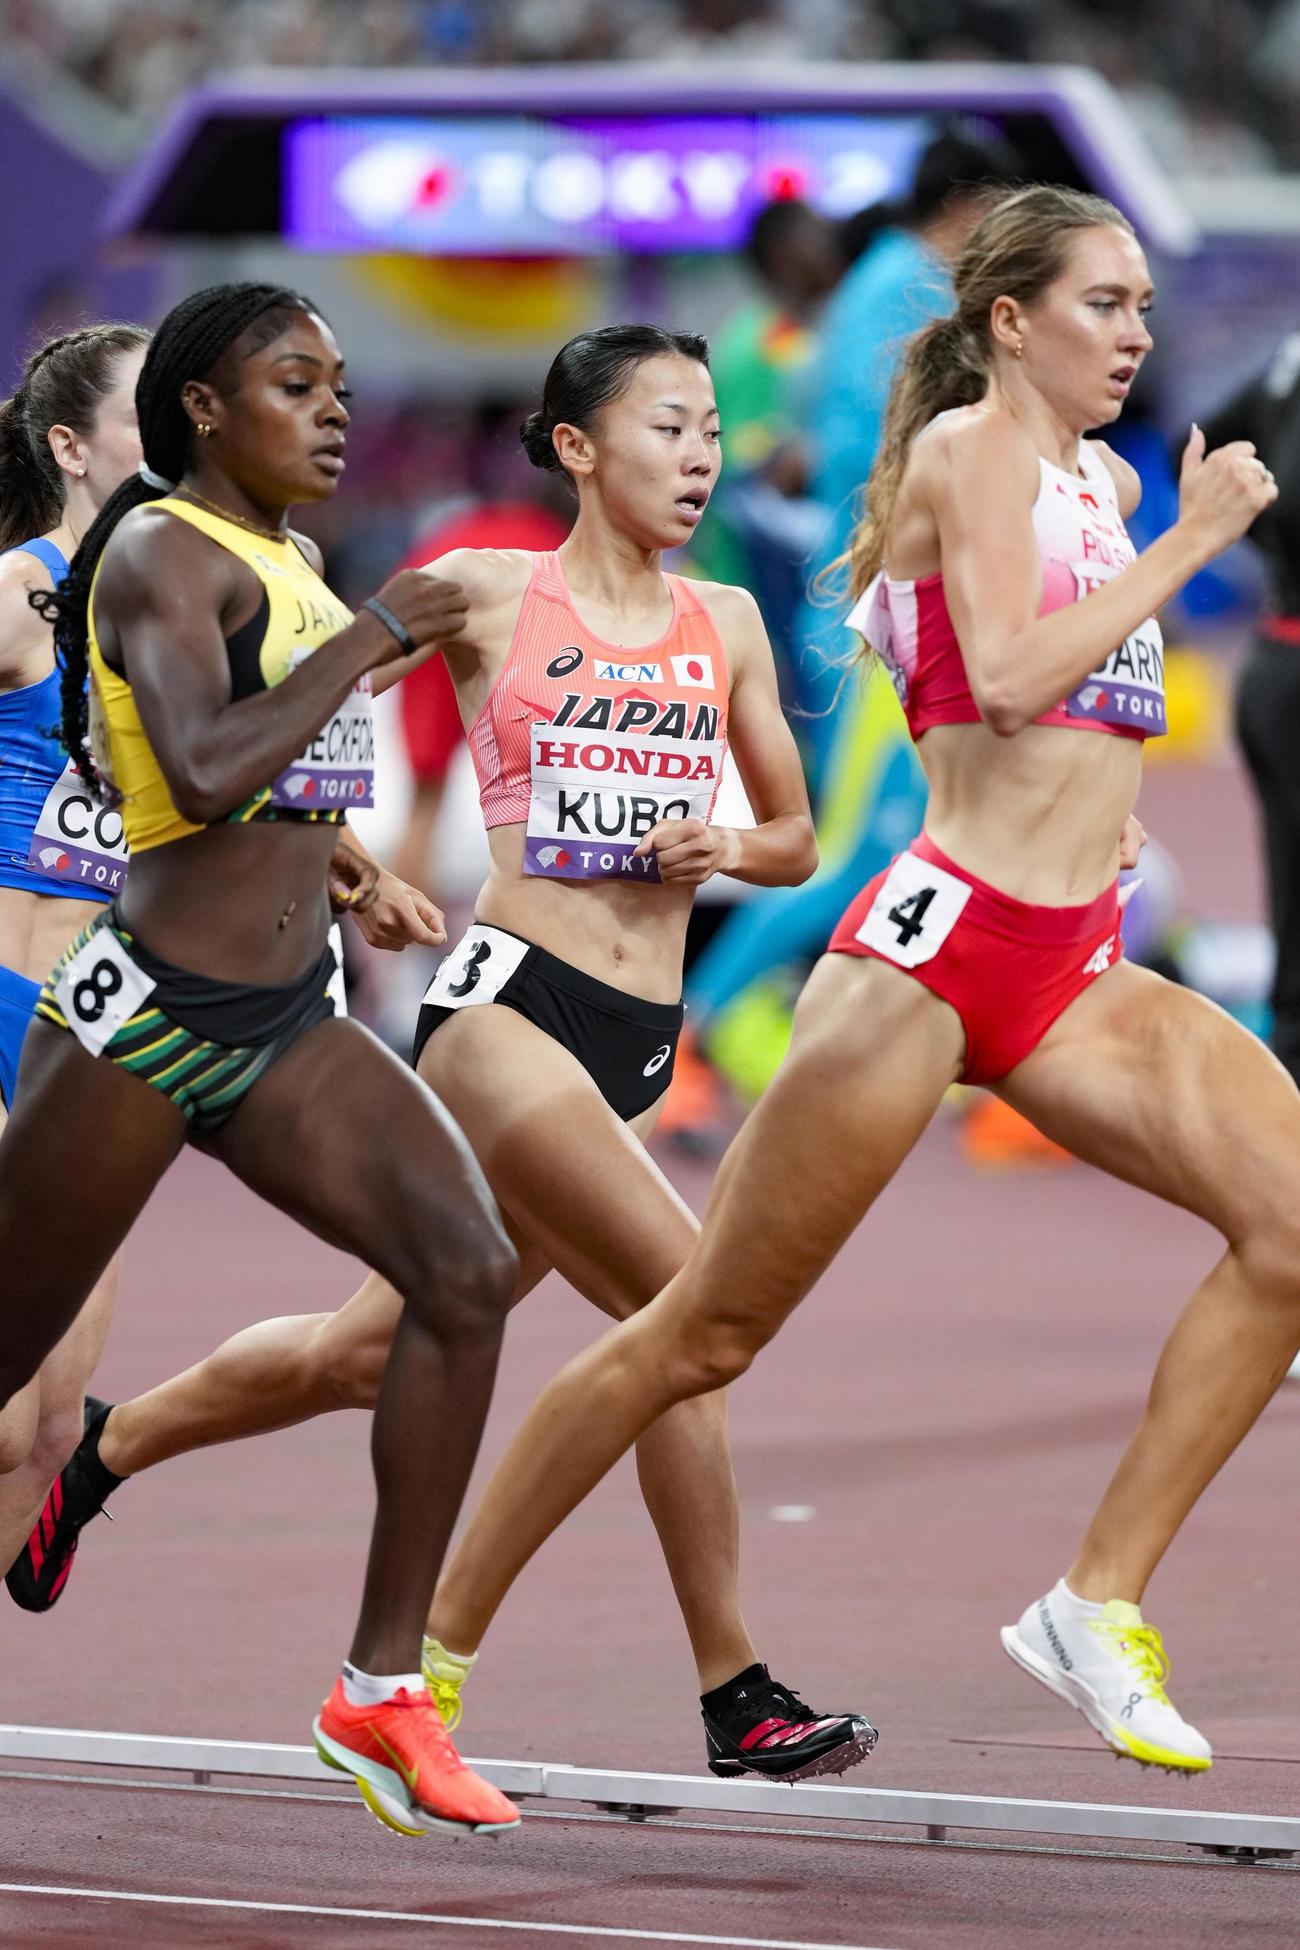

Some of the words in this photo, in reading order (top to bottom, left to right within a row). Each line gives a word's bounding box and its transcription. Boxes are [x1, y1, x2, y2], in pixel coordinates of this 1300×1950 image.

[598, 664, 657, 682] ACN
[535, 694, 718, 741] JAPAN
[535, 740, 716, 781] HONDA
[320, 777, 366, 800] TOKYO
[57, 794, 130, 855] CO
[79, 859, 129, 888] TOK
[888, 886, 938, 947] 4
[73, 958, 123, 1023] 8
[446, 939, 492, 998] 3
